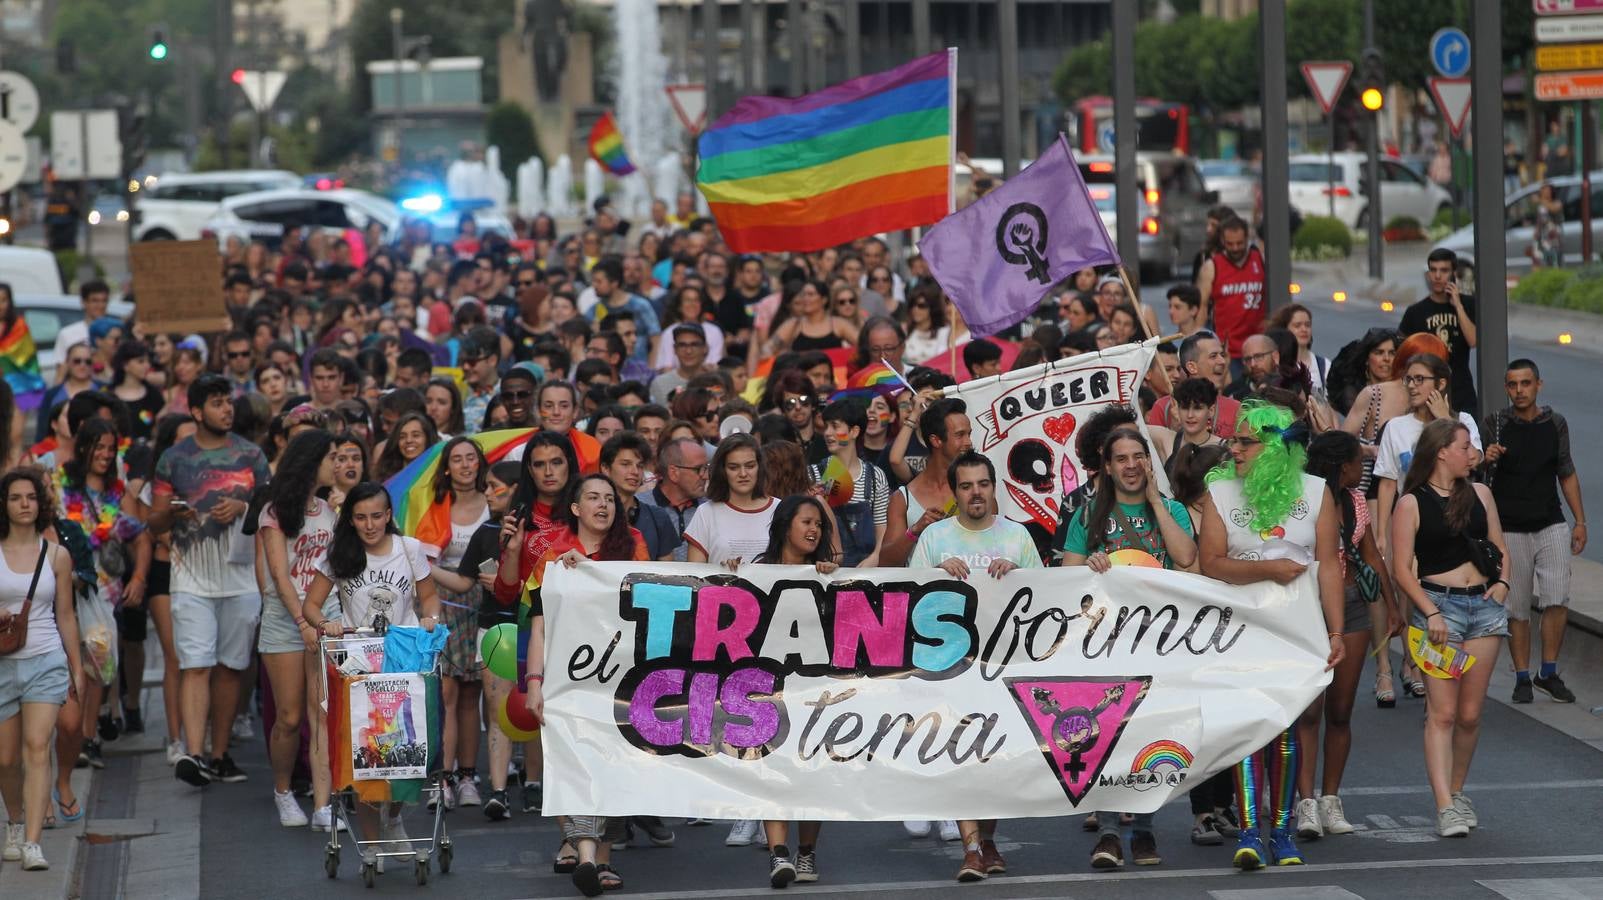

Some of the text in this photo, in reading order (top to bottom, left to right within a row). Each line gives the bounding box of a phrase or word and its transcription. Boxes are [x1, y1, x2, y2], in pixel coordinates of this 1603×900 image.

[1222, 282, 1262, 296] MIAMI
[1244, 292, 1262, 310] 32
[1000, 370, 1110, 420] QUEER
[343, 569, 411, 597] BABY CALL ME
[567, 630, 621, 684] el
